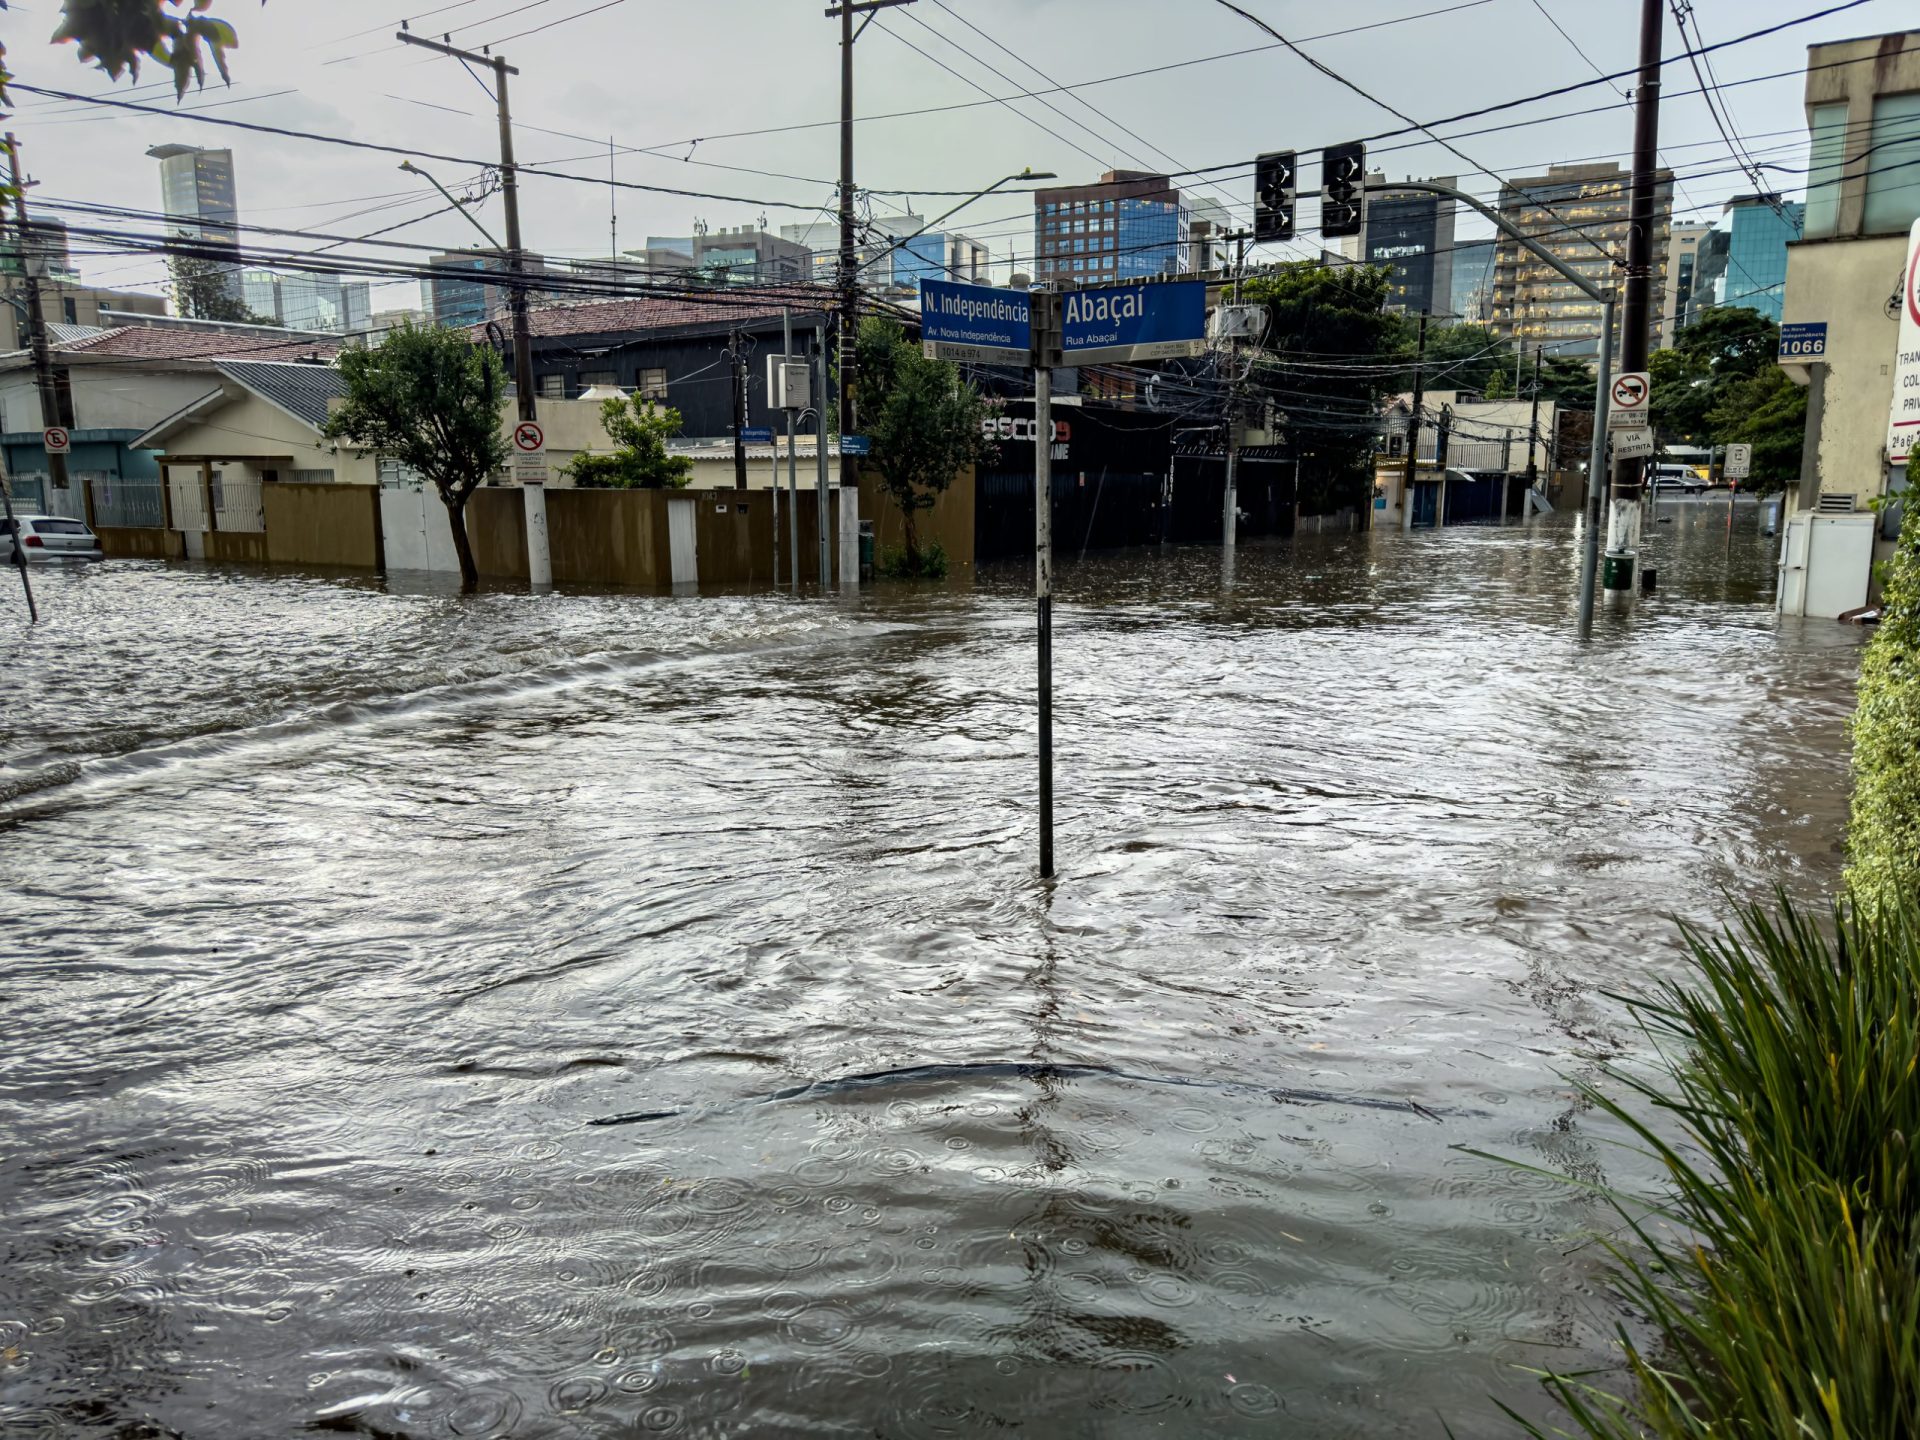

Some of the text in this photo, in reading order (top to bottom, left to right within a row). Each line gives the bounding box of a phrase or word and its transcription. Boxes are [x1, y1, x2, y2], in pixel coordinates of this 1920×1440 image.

[925, 291, 1029, 322] N. Independência
[1066, 286, 1145, 327] Abaçaí
[940, 327, 959, 338] Nova
[960, 330, 1011, 343] Independência
[1066, 331, 1118, 346] Rua Abaçaí
[1781, 339, 1823, 354] 1066
[1626, 434, 1641, 442] VIA
[1617, 443, 1652, 453] RESTRITA
